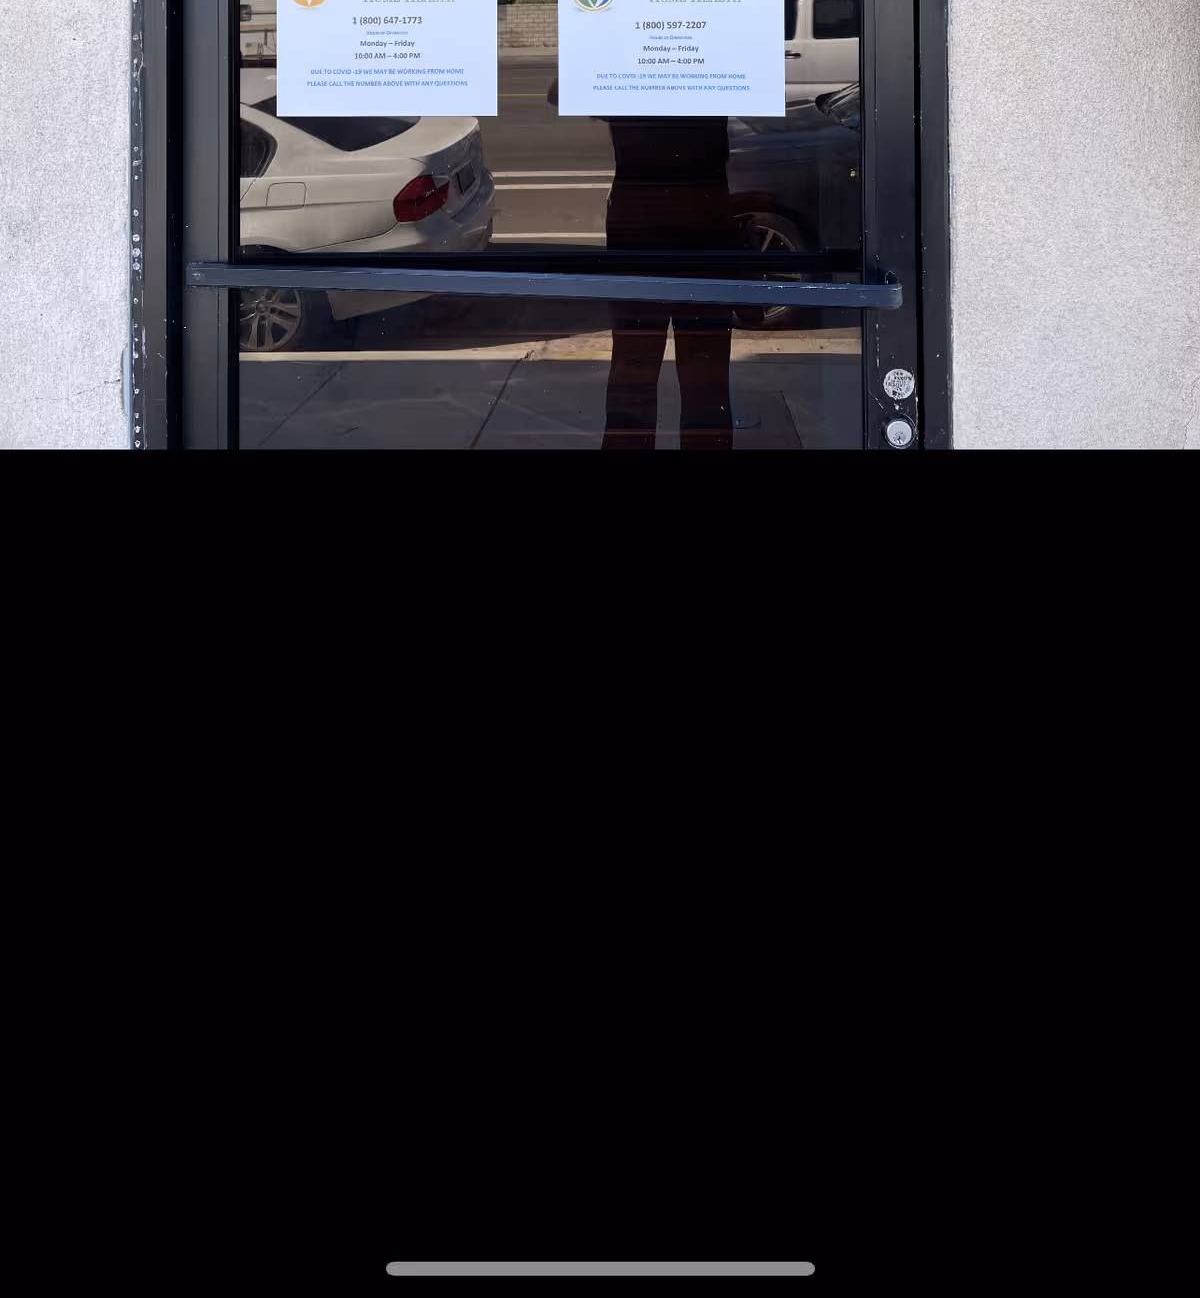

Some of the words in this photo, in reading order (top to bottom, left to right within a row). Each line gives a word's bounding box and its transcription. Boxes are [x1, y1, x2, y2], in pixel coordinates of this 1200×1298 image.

[360, 17, 381, 25] (800)
[384, 17, 423, 25] 647-1773
[643, 21, 665, 30] (800)
[360, 40, 387, 48] Monday
[395, 40, 415, 48] Friday
